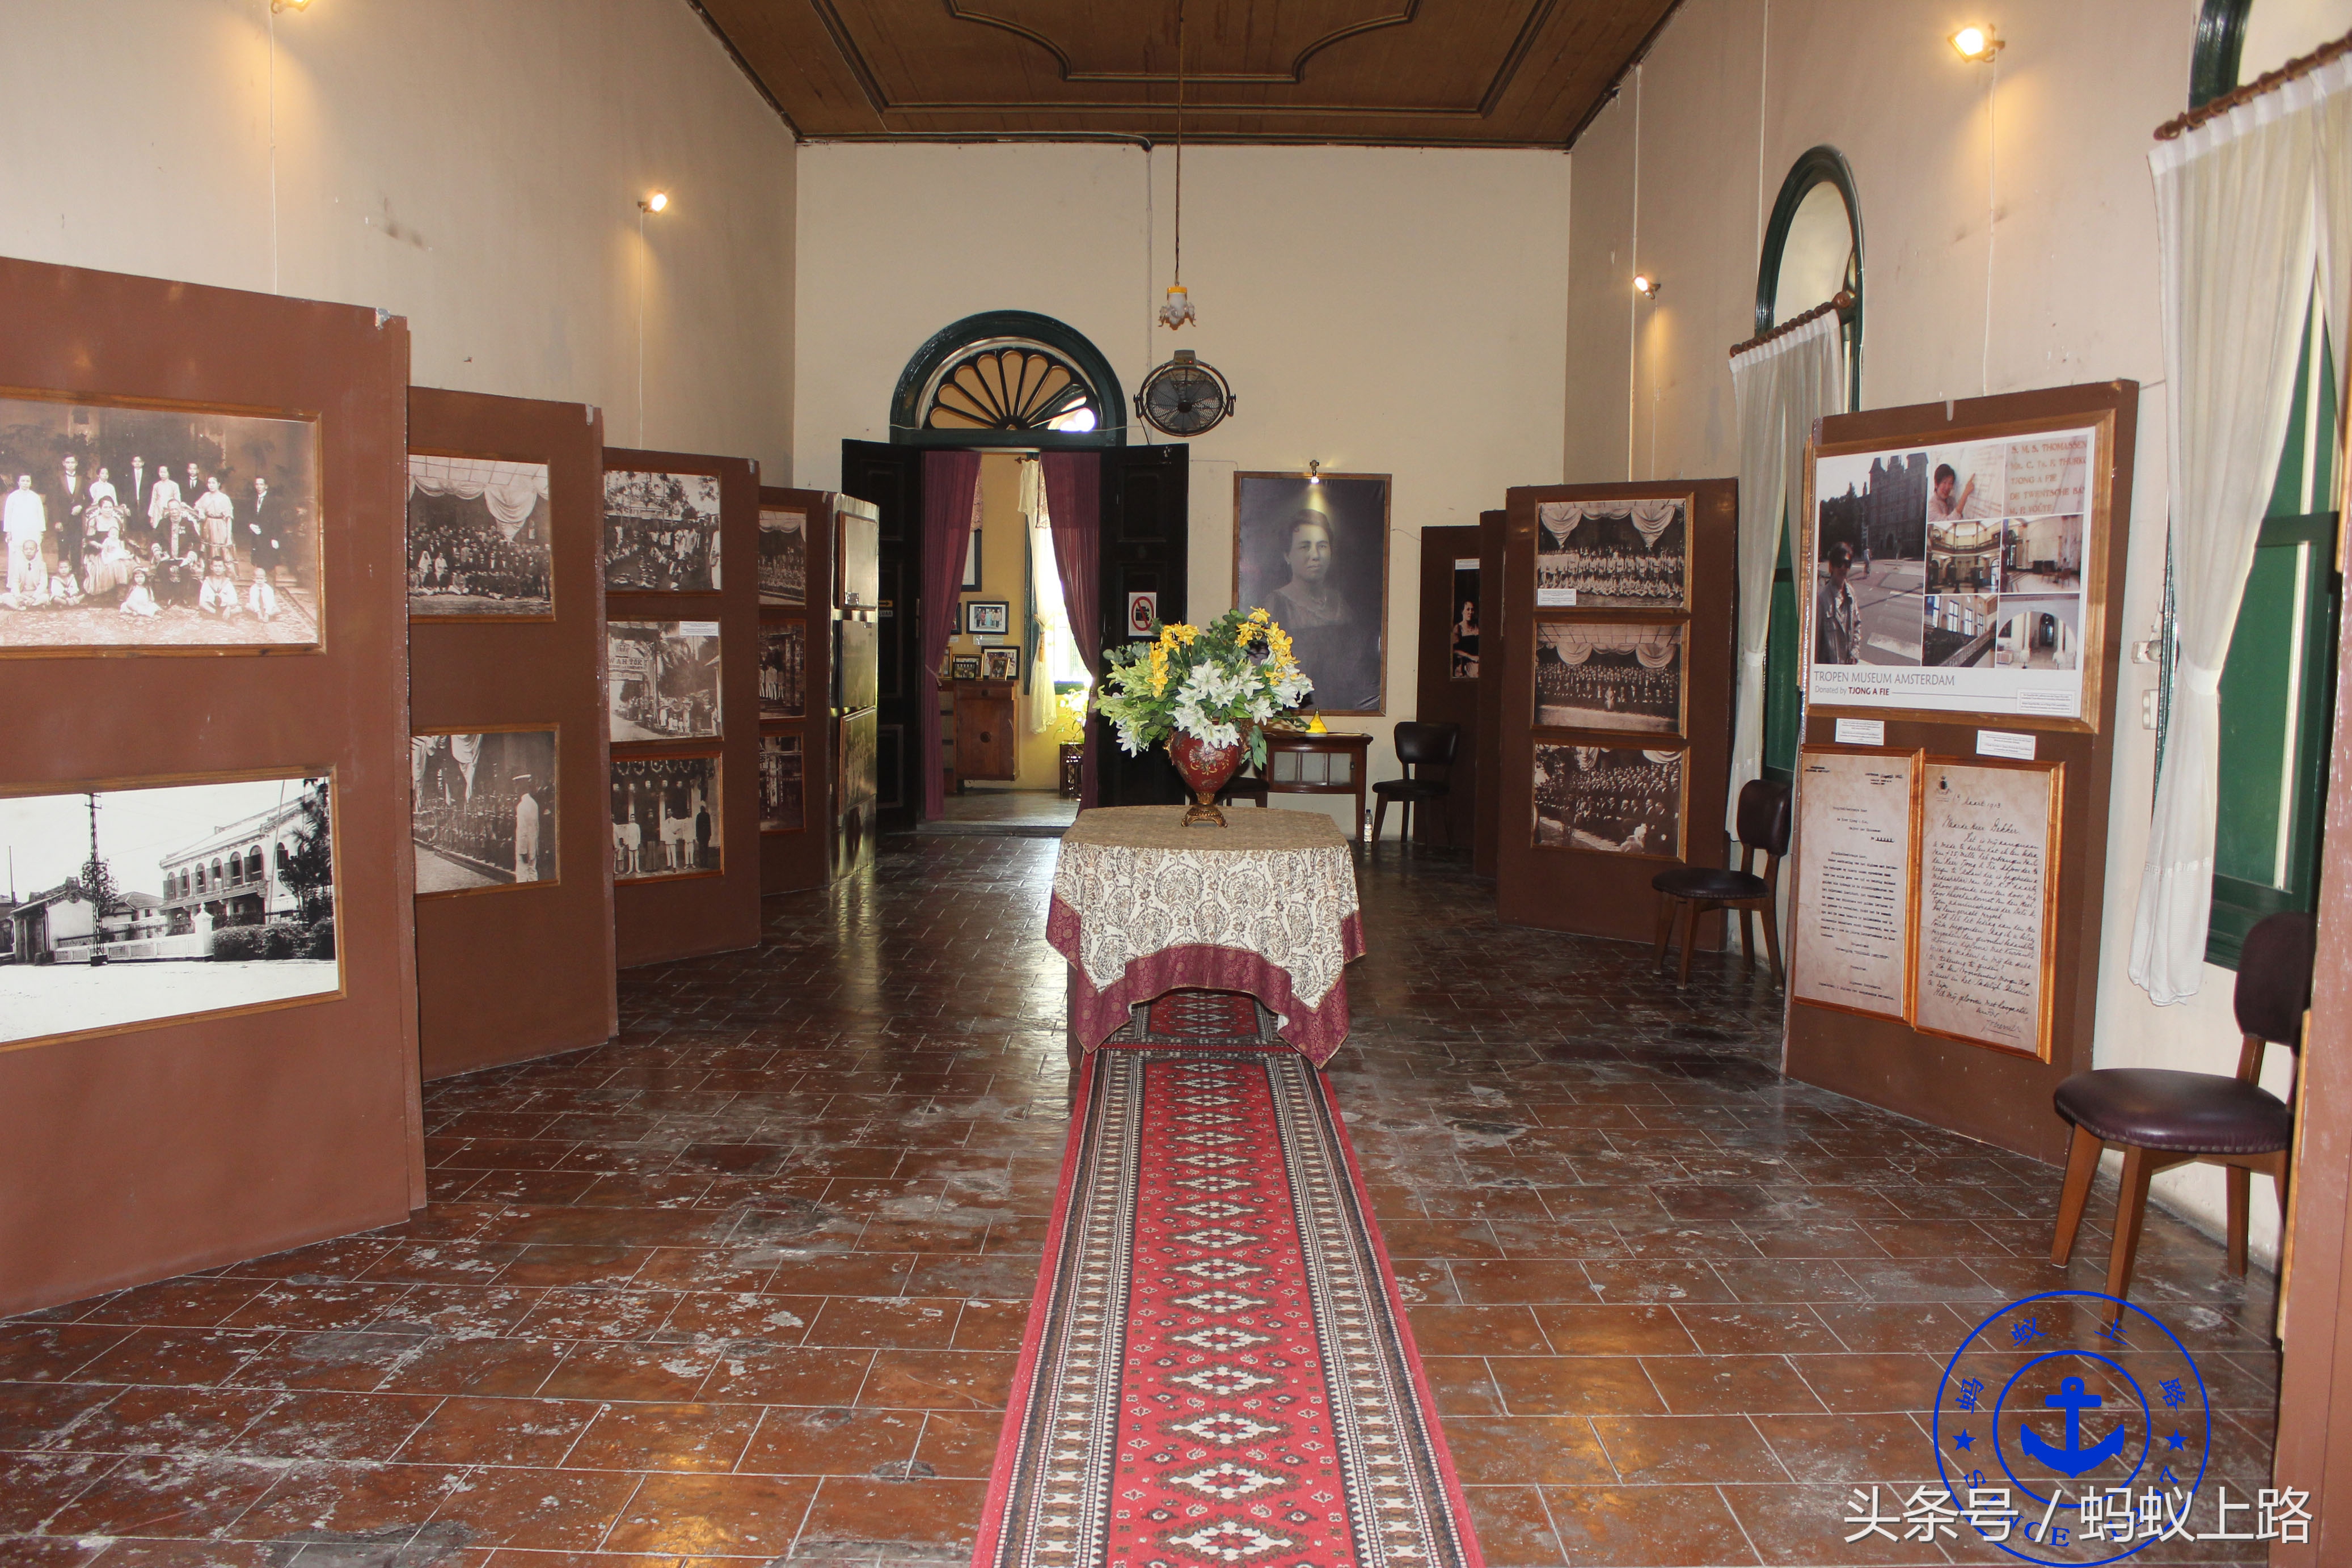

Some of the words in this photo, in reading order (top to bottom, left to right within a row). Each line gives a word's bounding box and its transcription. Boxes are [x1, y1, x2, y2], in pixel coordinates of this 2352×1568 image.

[1814, 671, 1849, 682] TROPEN
[1851, 672, 1891, 684] MUSEUM
[1894, 673, 1955, 686] AMSTERDAM
[1815, 685, 1838, 694] Donated
[1839, 686, 1847, 695] by
[1848, 686, 1871, 695] TJONG
